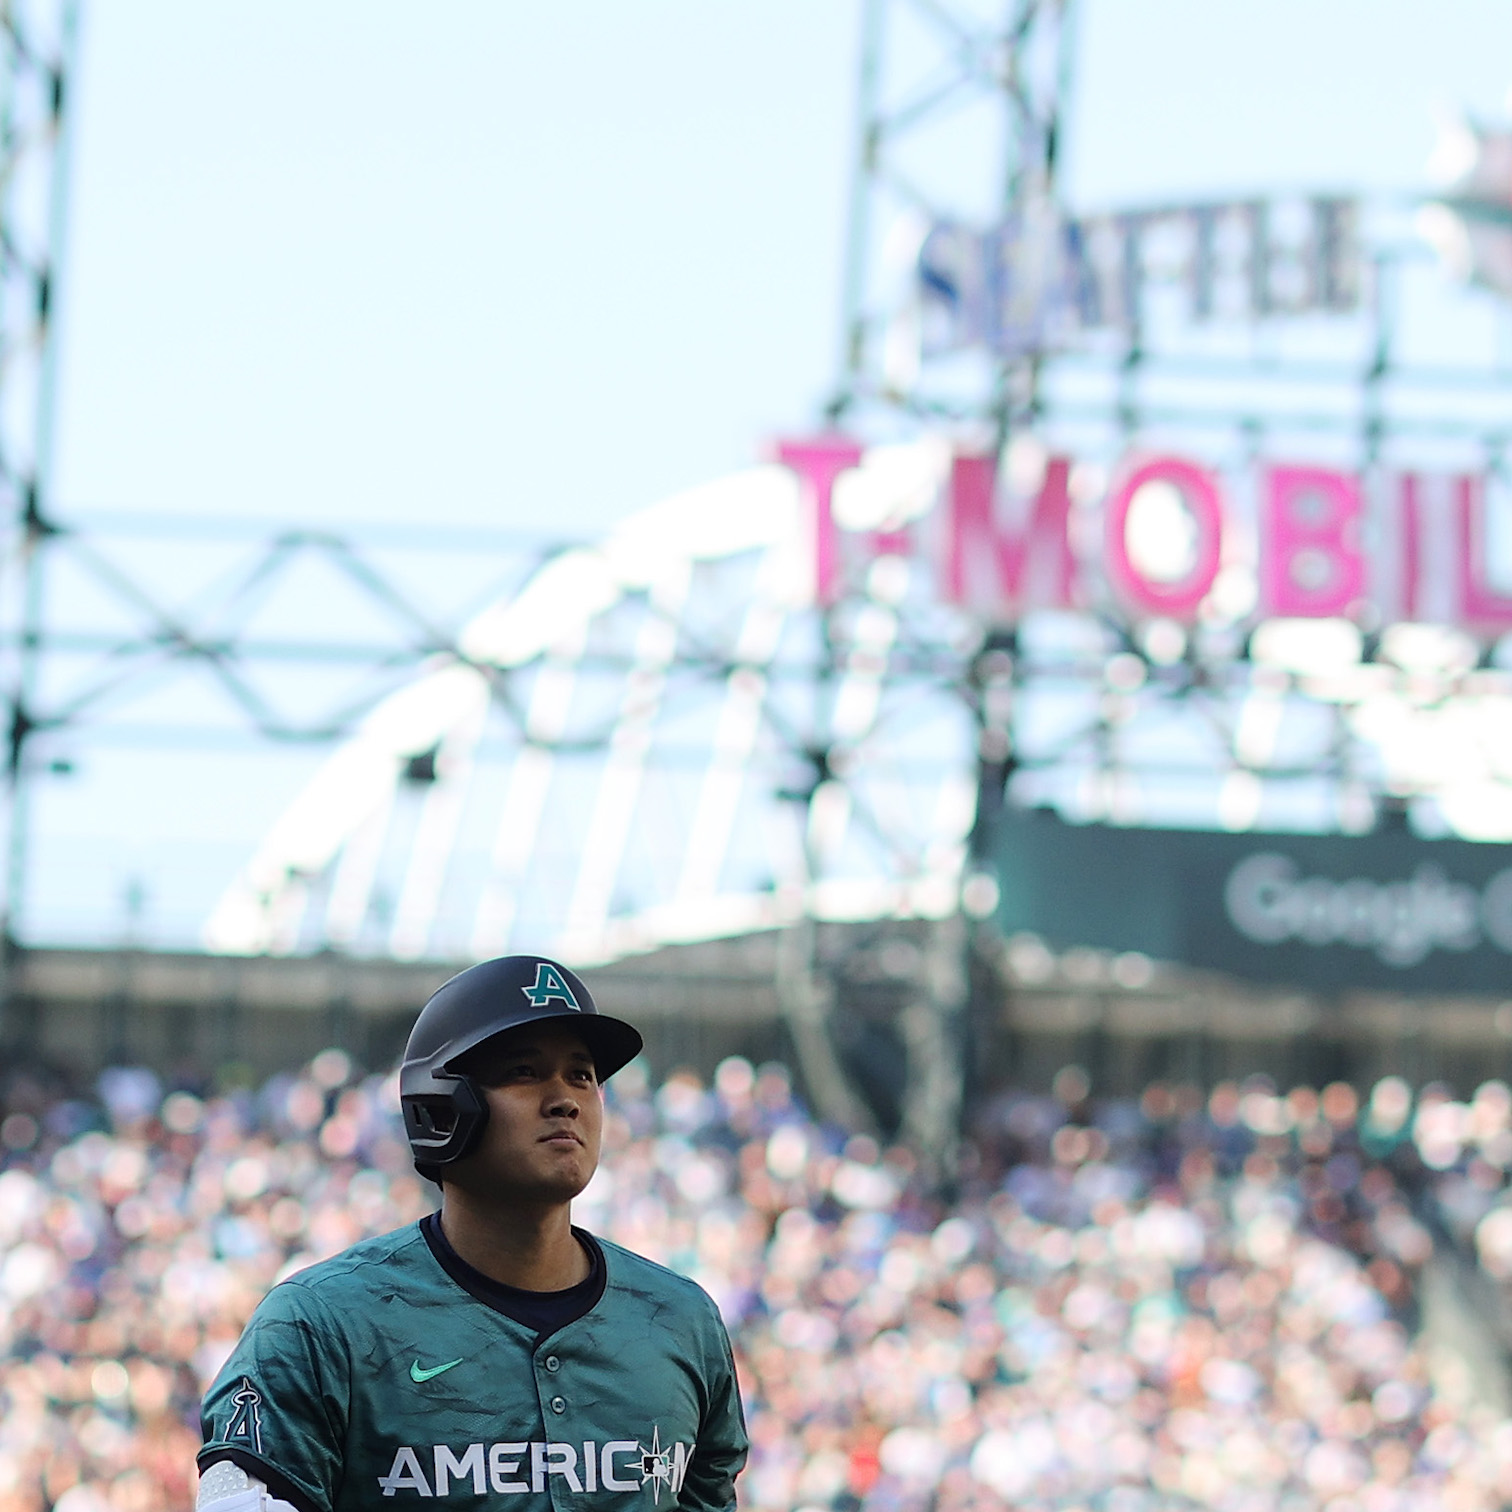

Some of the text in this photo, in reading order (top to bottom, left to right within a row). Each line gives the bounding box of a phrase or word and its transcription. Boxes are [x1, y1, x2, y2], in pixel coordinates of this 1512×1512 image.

[1224, 852, 1480, 967] Google
[521, 962, 581, 1012] A
[378, 1438, 697, 1498] AMERICN
